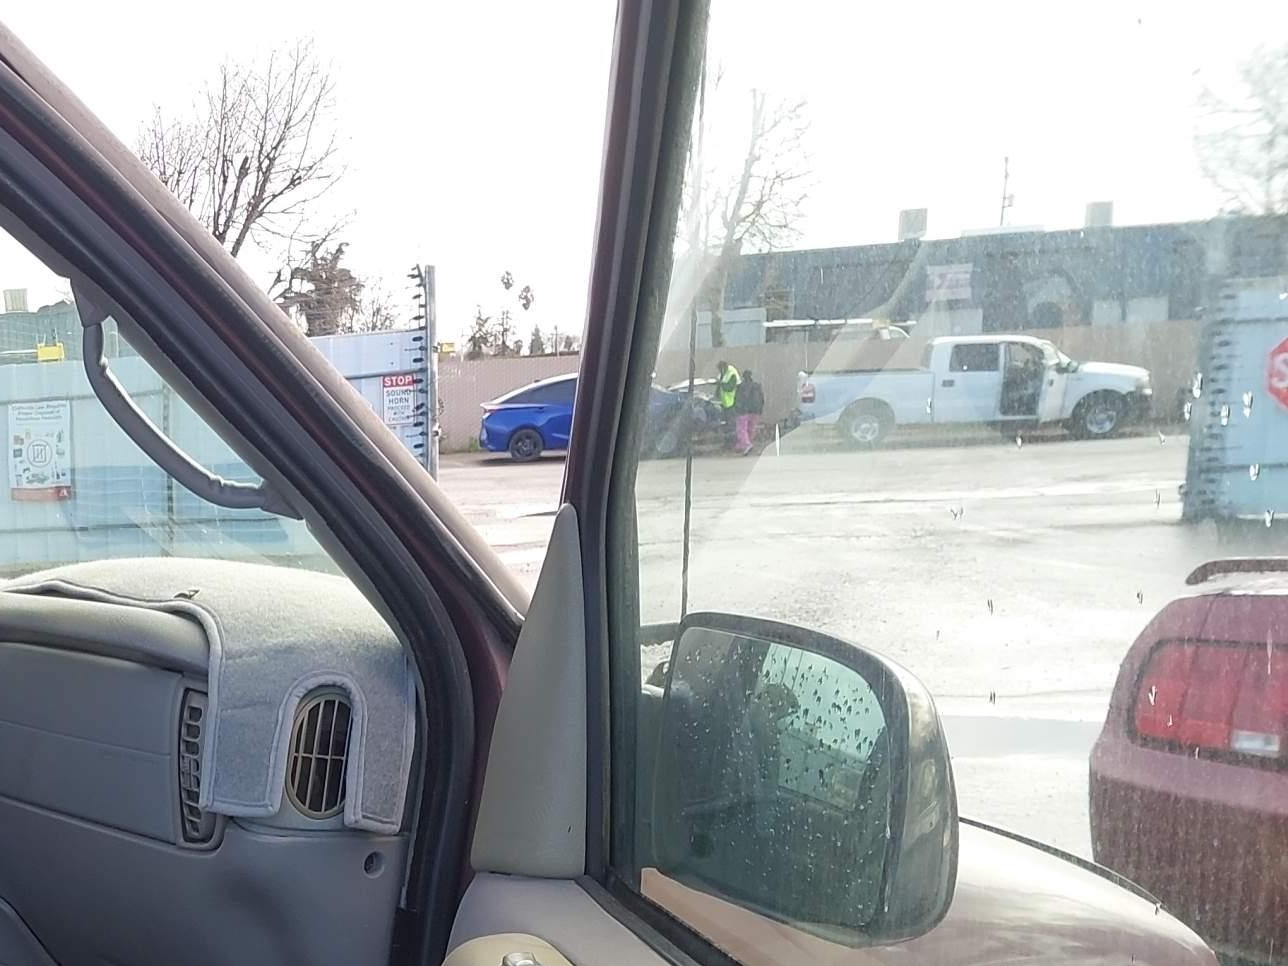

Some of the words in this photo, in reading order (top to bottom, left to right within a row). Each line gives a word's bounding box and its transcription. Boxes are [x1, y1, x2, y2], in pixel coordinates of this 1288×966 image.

[383, 375, 413, 386] STOP
[385, 389, 411, 397] SOUND
[388, 397, 410, 405] HORN
